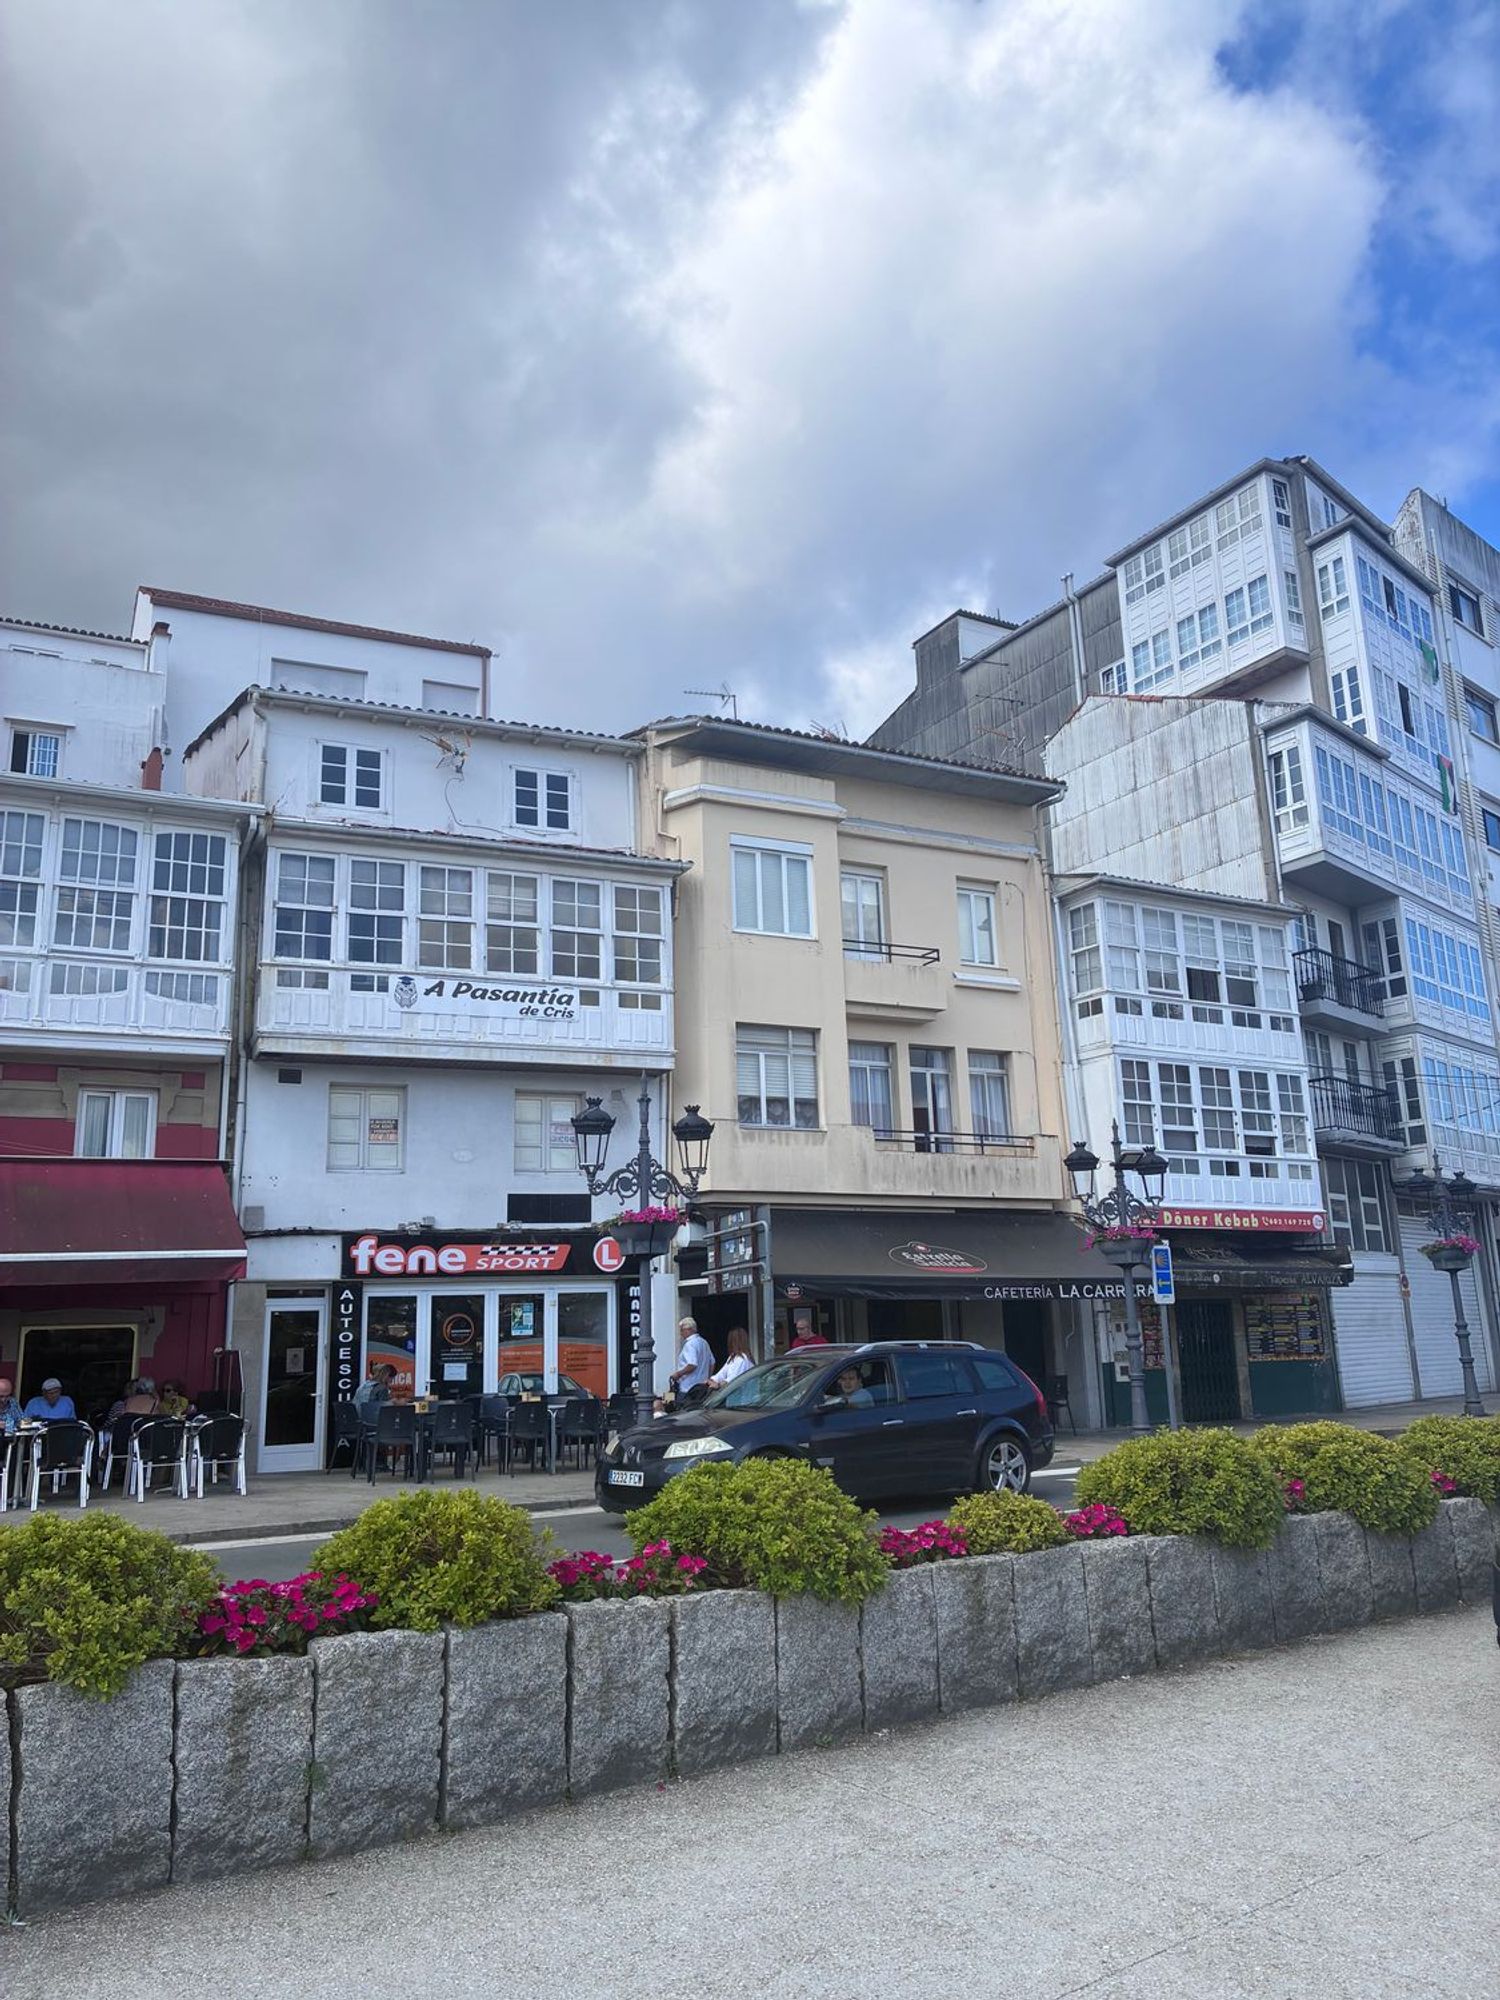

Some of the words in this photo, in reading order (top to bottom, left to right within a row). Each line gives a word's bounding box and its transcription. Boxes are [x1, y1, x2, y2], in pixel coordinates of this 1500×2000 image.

[423, 980, 445, 997] A
[452, 981, 575, 1006] Pasantía
[519, 1005, 539, 1016] de
[543, 1006, 575, 1019] Cris
[1214, 1212, 1259, 1228] Kebab
[351, 1237, 467, 1273] fene
[602, 1243, 618, 1266] L
[475, 1257, 555, 1270] SPORT
[984, 1284, 1053, 1299] CAFETERÍA
[1058, 1284, 1080, 1298] LA
[1083, 1284, 1155, 1298] CARRRA
